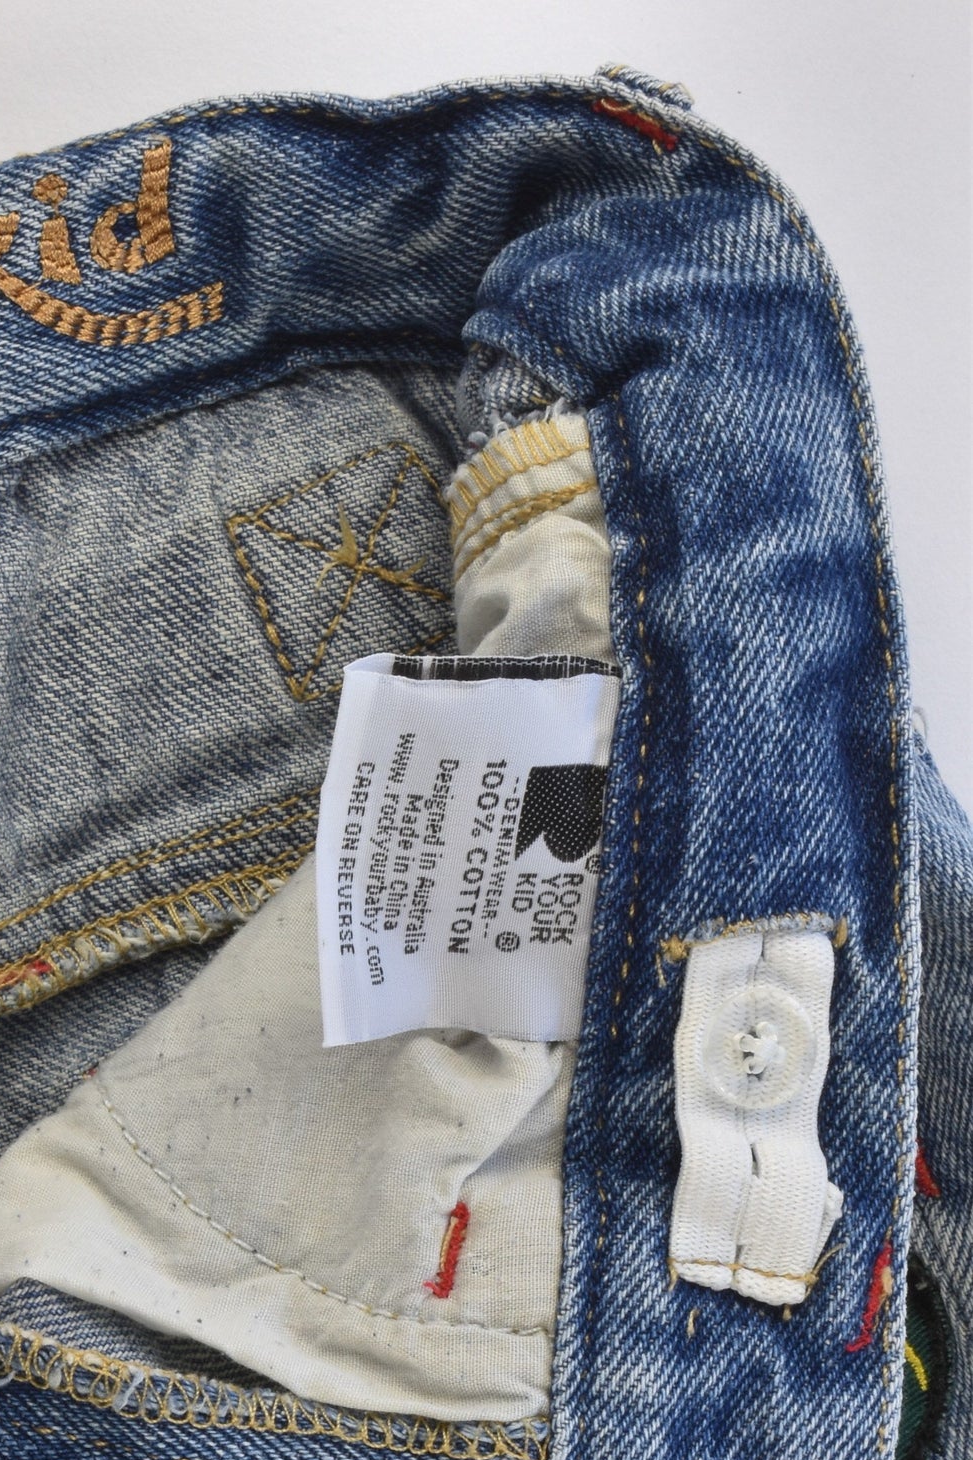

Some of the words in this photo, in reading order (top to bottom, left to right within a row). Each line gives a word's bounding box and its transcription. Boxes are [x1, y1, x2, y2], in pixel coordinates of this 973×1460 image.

[348, 761, 376, 815] CARE
[421, 758, 460, 846] Designed
[471, 759, 508, 838] 100%
[341, 822, 363, 852] ON
[398, 793, 424, 851] Made
[393, 855, 415, 873] in
[419, 852, 442, 871] in
[512, 872, 539, 914] KID
[337, 856, 357, 956] REVERSE
[384, 879, 409, 932] China
[404, 876, 435, 956] Australia
[447, 849, 488, 955] COTTON
[530, 873, 562, 944] YOUR
[552, 872, 585, 946] ROCK
